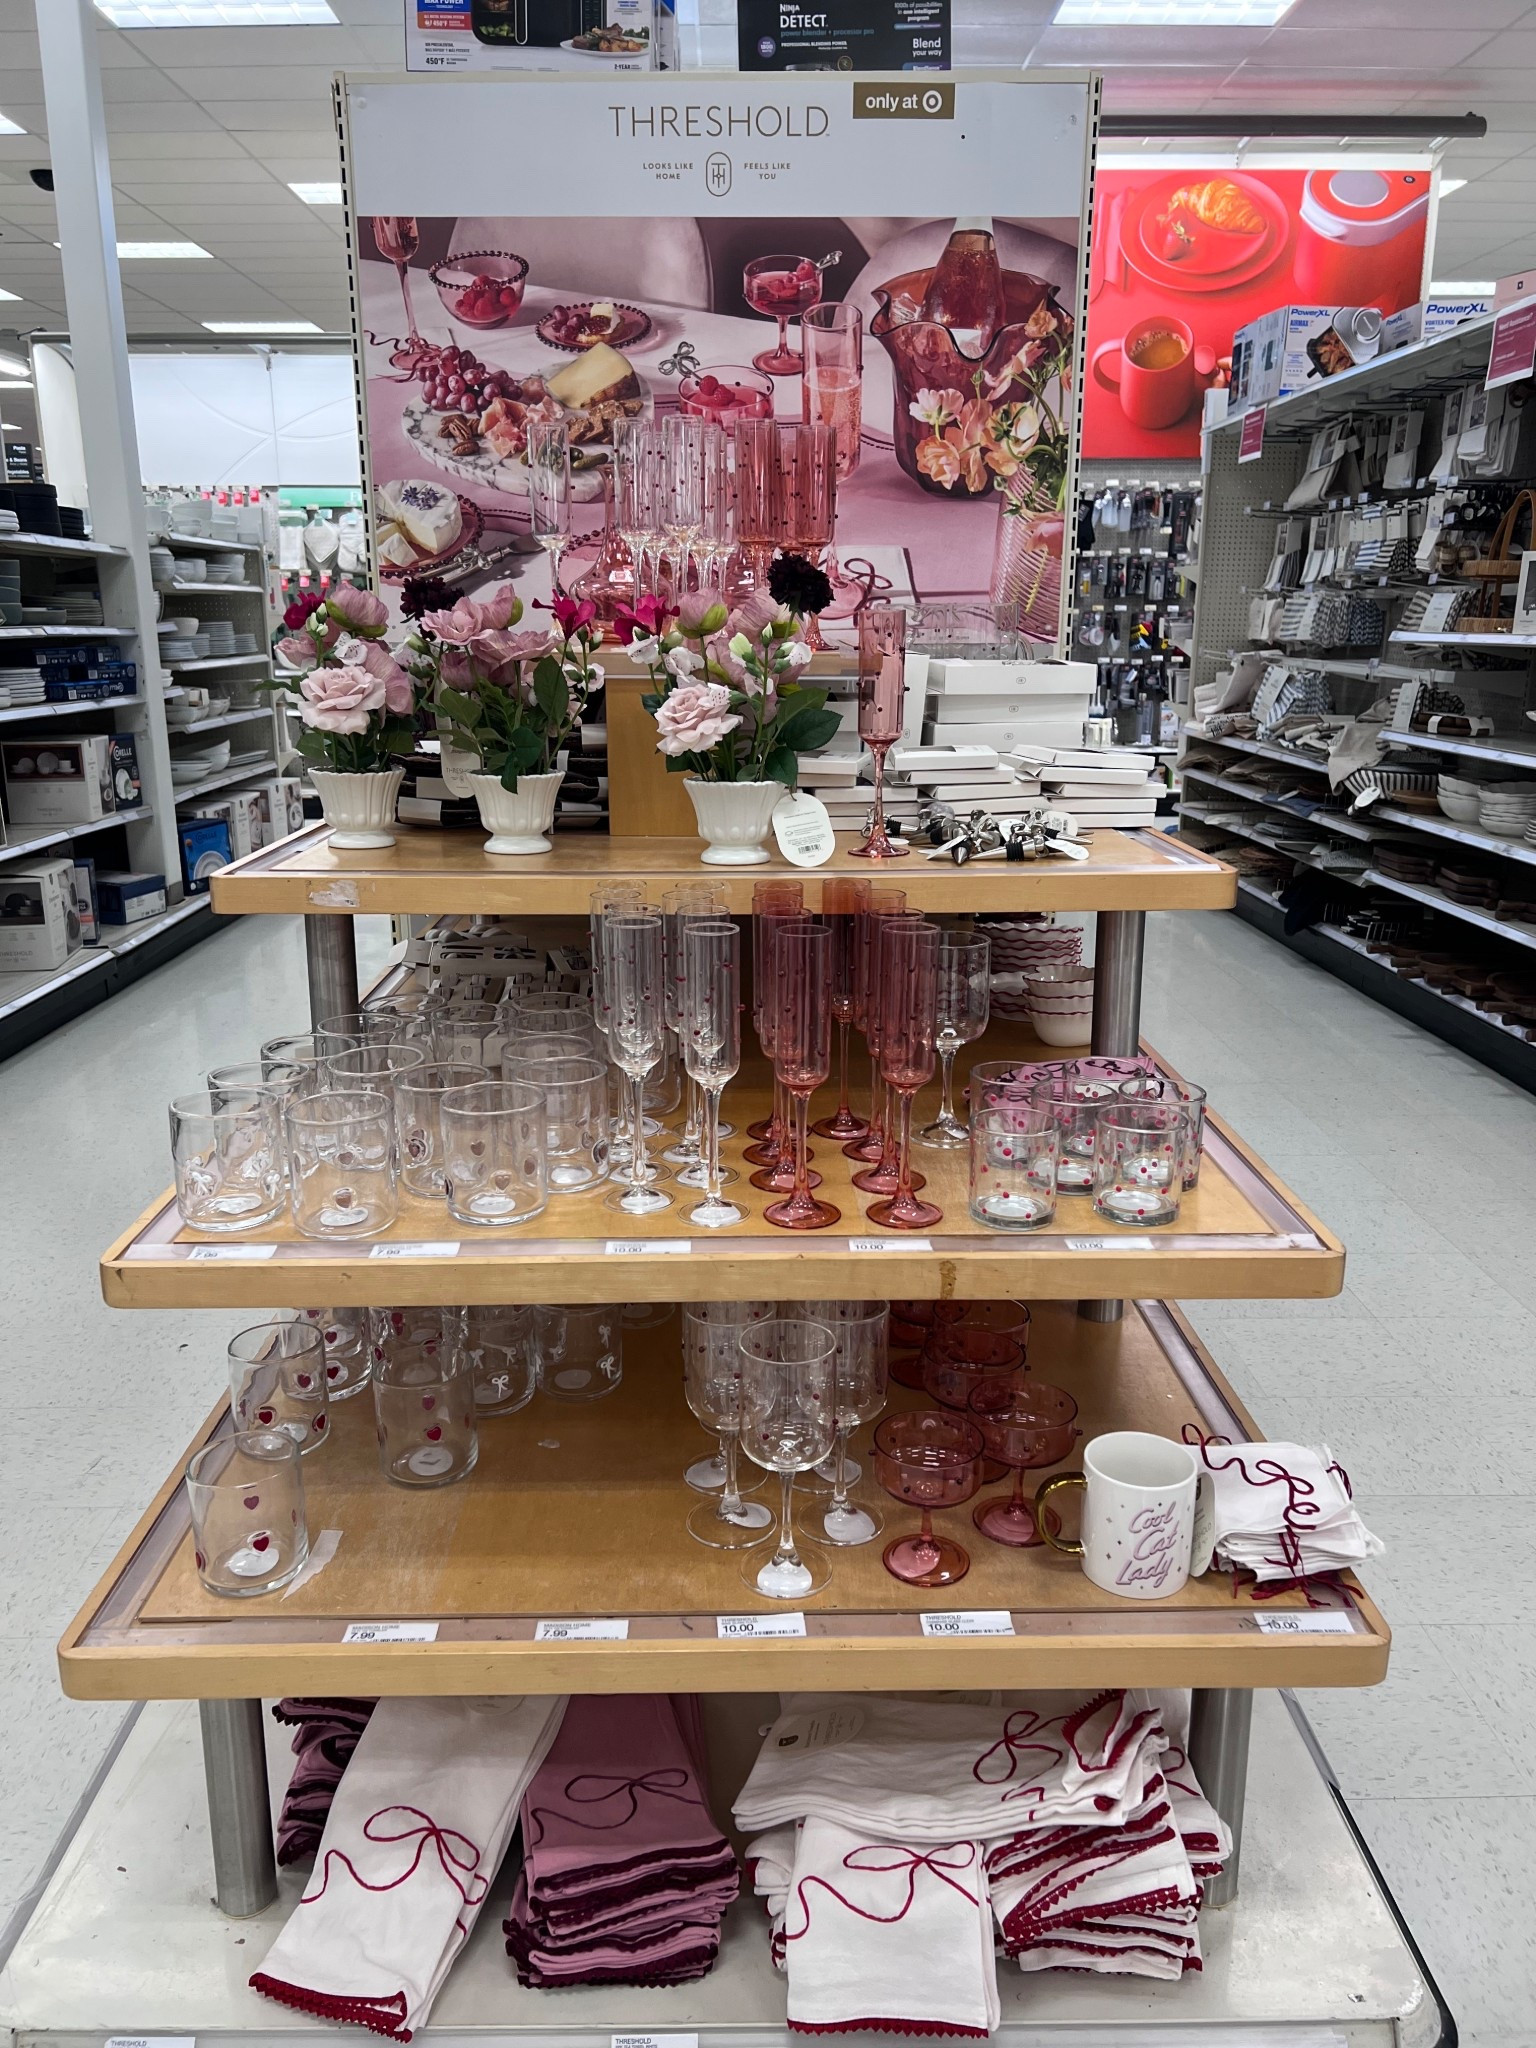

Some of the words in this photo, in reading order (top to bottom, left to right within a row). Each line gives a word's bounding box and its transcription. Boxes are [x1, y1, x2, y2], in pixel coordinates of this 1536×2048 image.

[780, 4, 800, 13] NINJA
[780, 14, 827, 28] DETECT
[802, 28, 827, 36] blender
[912, 36, 942, 48] Blend
[912, 49, 927, 58] your
[928, 49, 943, 57] way
[865, 92, 899, 112] only
[902, 94, 918, 108] at
[608, 105, 829, 137] THRESHOLD
[642, 162, 672, 170] LOOKS
[674, 162, 694, 170] LIKE
[743, 162, 769, 170] FEELS
[772, 162, 791, 170] LIKE
[655, 172, 681, 180] HOME
[758, 172, 777, 180] YOU
[1290, 308, 1331, 318] PowerXL
[1426, 302, 1489, 316] PowerXL
[1128, 1500, 1177, 1534] Cool
[1133, 1519, 1180, 1561] Cat
[1115, 1551, 1174, 1589] Lady
[723, 1623, 754, 1633] 10.00
[928, 1623, 960, 1631] 10.00
[350, 1632, 376, 1640] 7.99
[543, 1629, 568, 1638] 7.99
